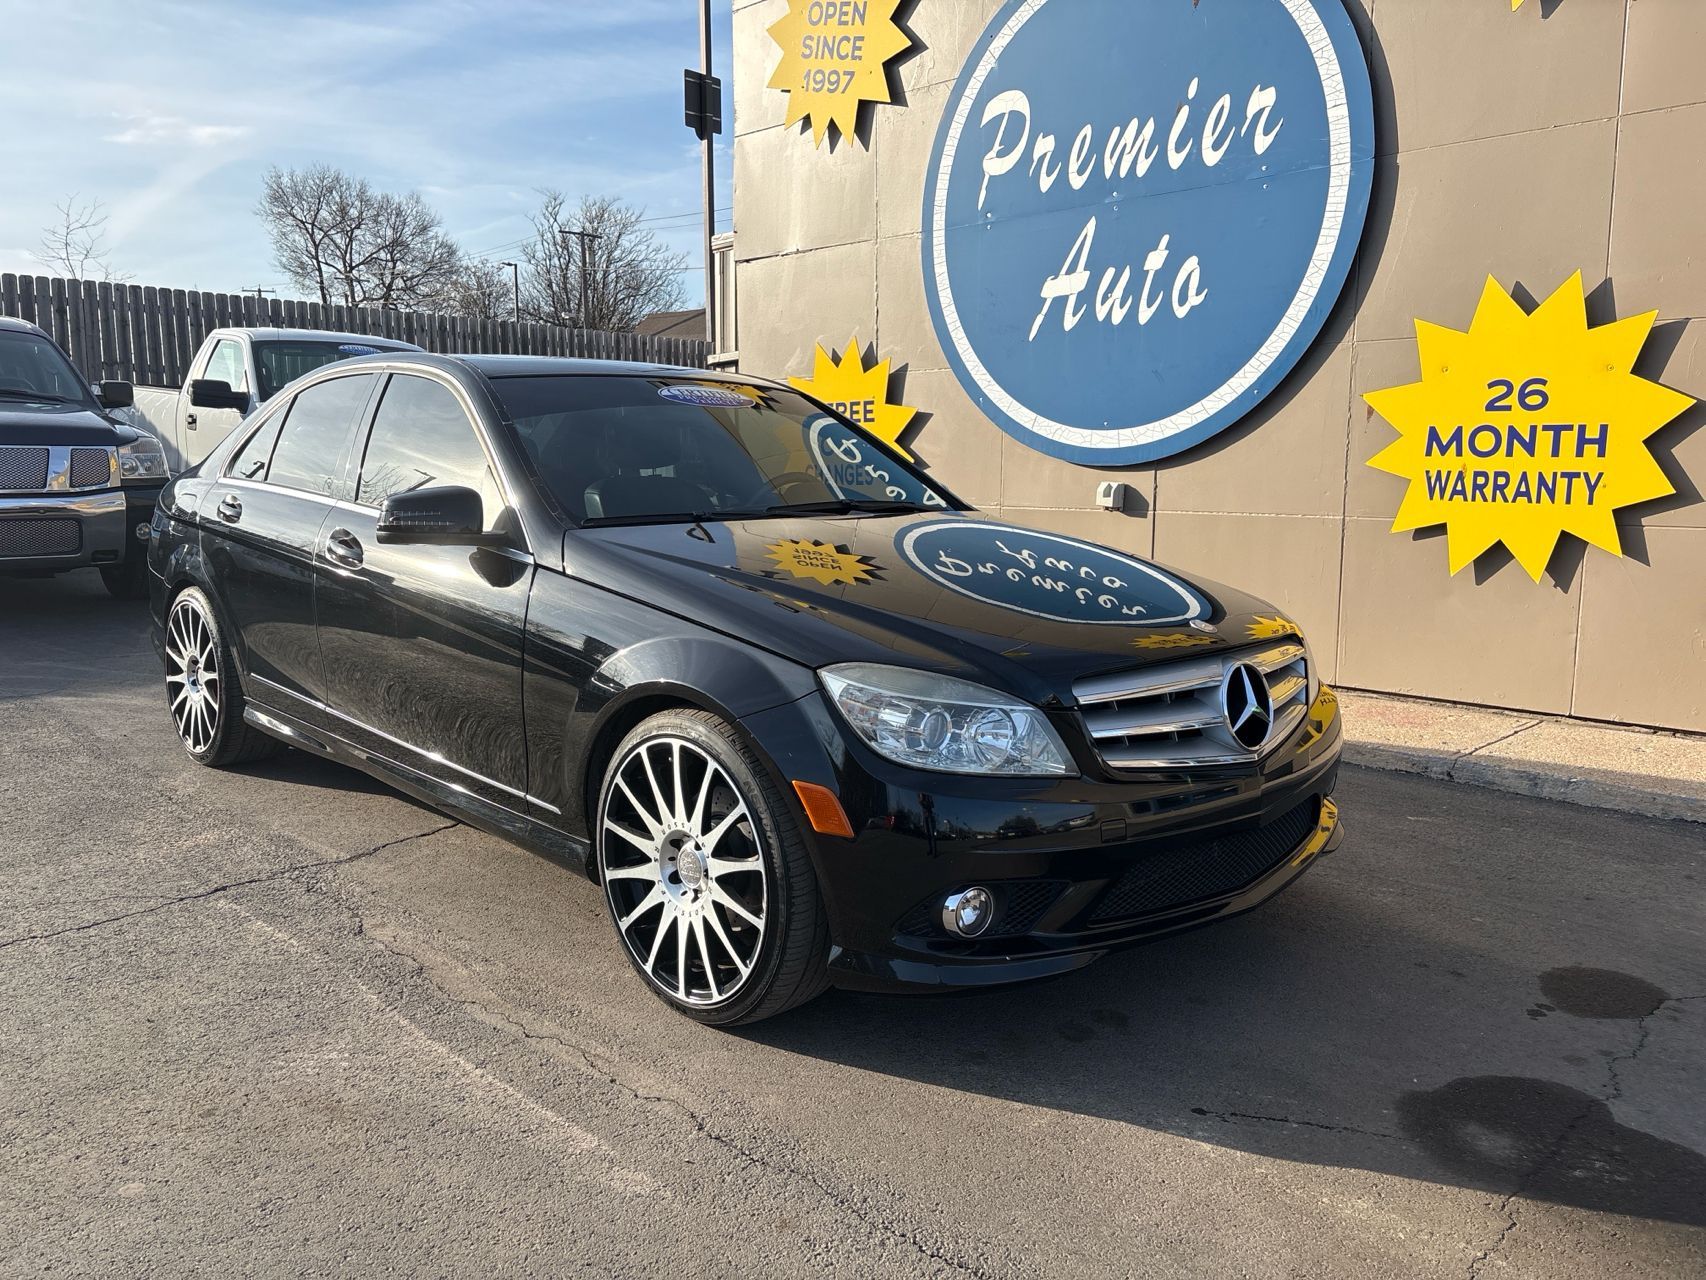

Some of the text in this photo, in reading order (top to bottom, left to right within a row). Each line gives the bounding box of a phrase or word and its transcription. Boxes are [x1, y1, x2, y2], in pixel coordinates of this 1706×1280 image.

[807, 1, 867, 26] OPEN
[801, 35, 865, 61] SINCE
[803, 69, 856, 94] 1997
[977, 77, 1285, 210] Premier
[1028, 215, 1208, 341] Auto
[1484, 377, 1550, 412] 26
[1424, 423, 1609, 458] MONTH
[1425, 469, 1604, 505] WARRANTY
